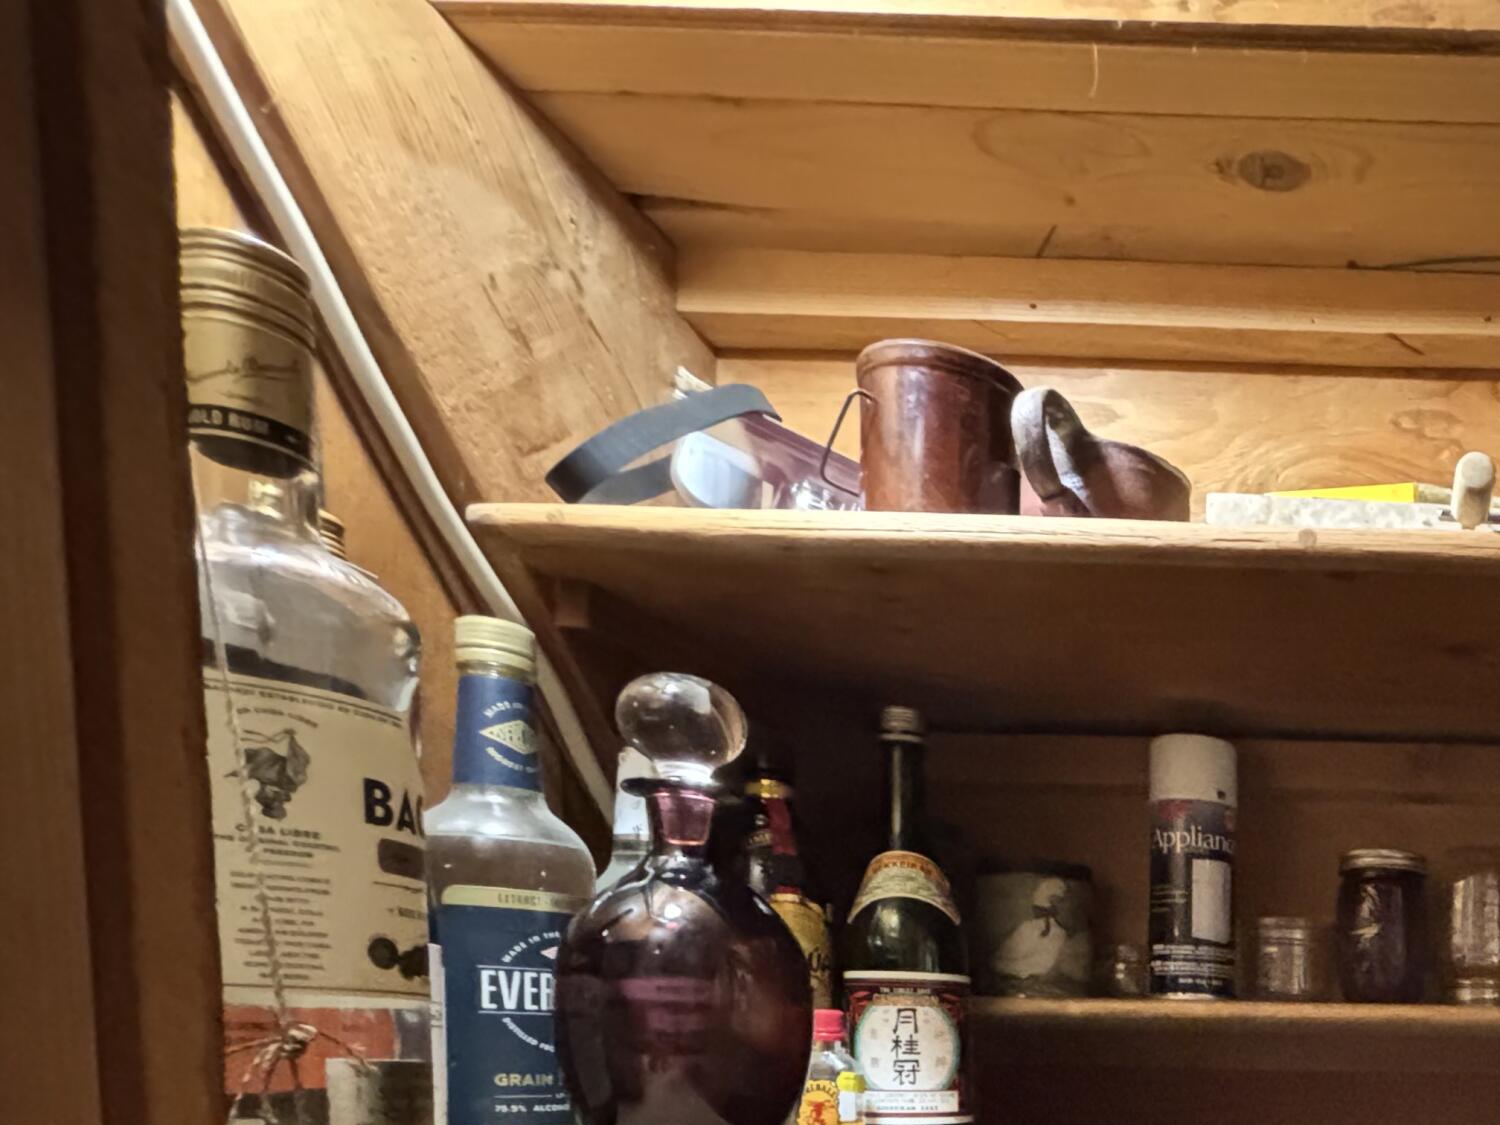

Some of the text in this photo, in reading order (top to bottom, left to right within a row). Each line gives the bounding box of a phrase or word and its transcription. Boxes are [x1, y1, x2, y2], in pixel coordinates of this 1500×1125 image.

[501, 940, 528, 963] MADE
[890, 1007, 921, 1086] 月桂冠
[494, 1073, 554, 1087] GRAIN
